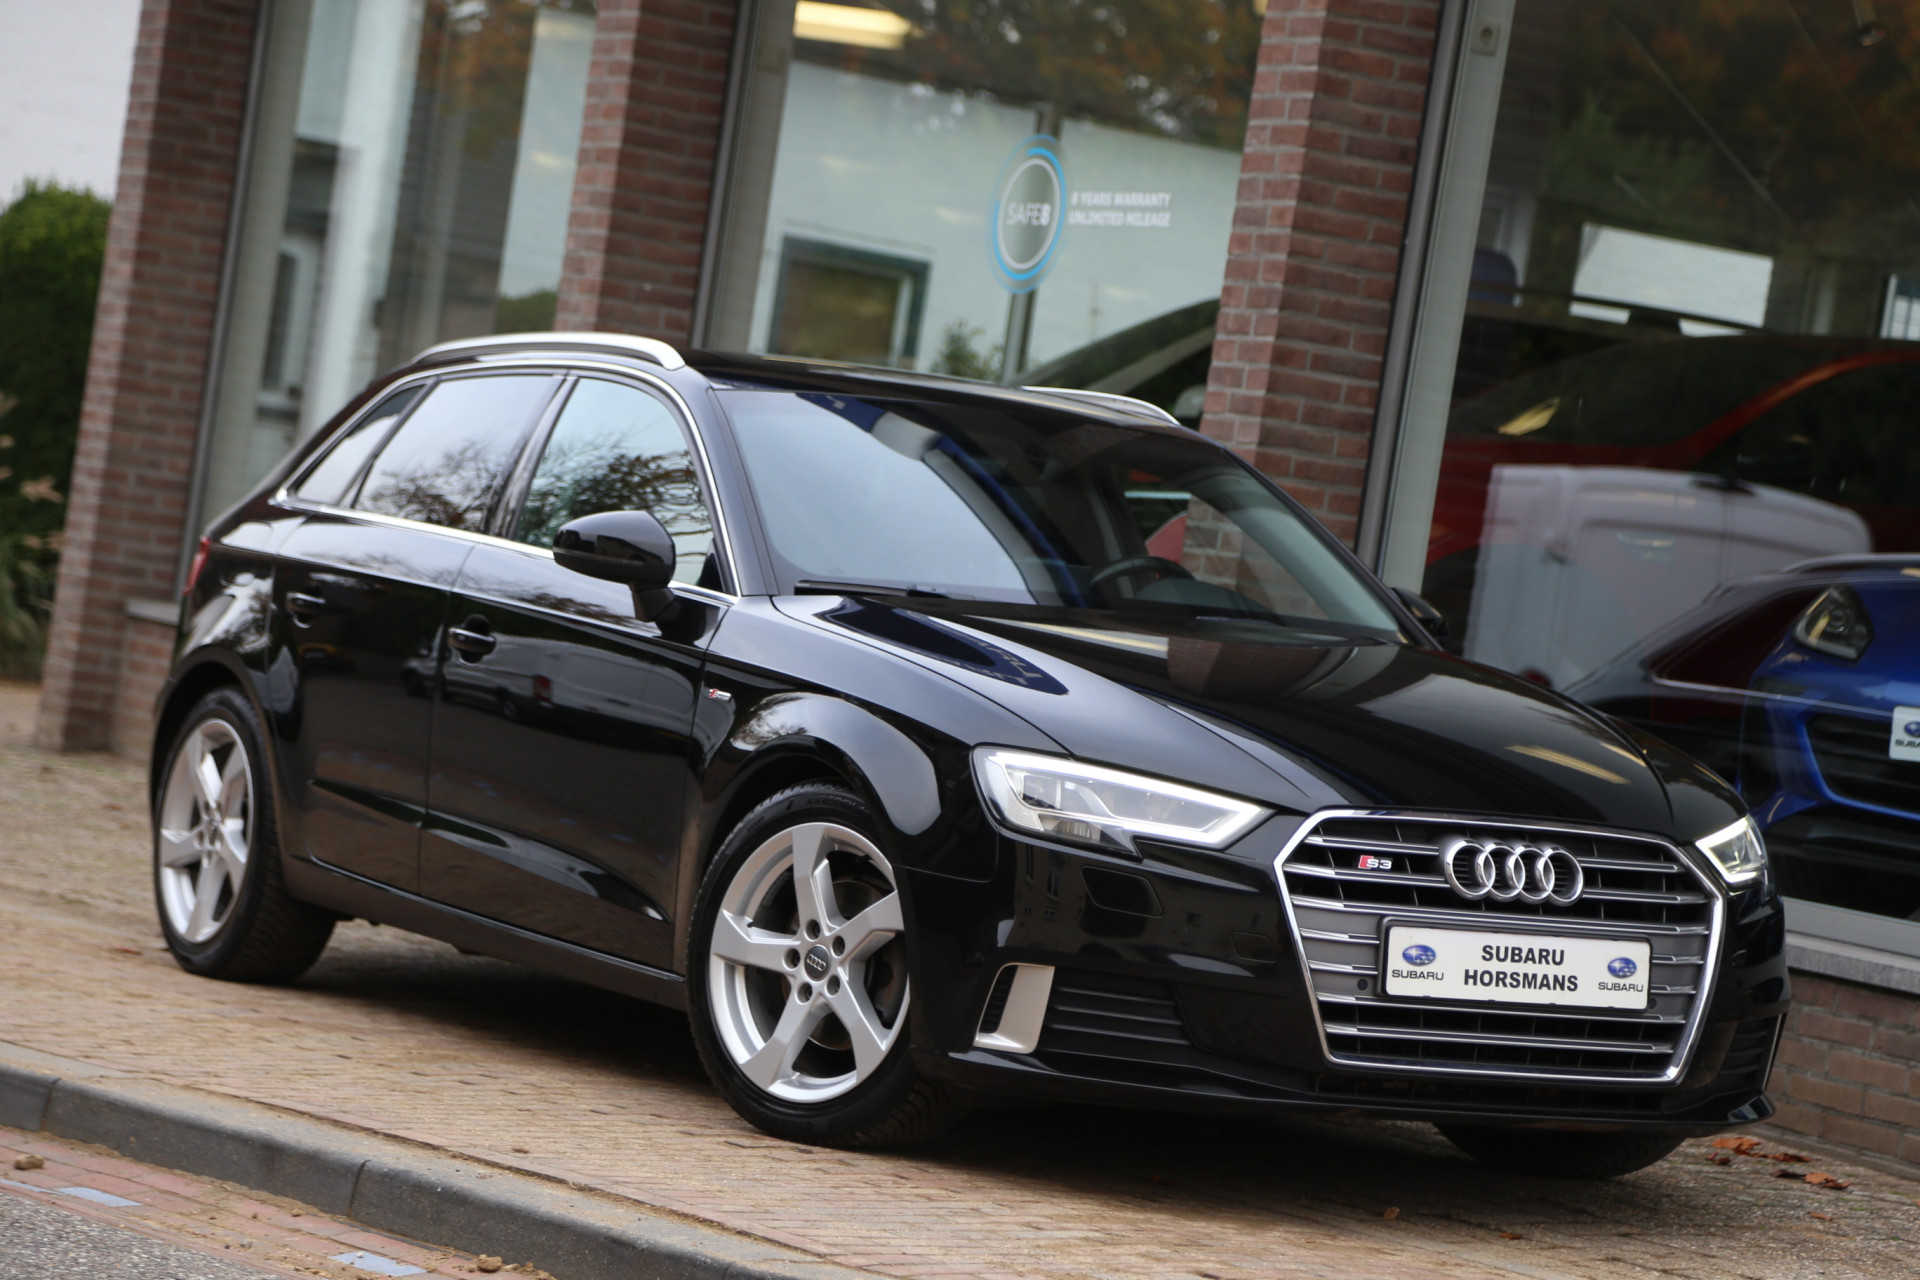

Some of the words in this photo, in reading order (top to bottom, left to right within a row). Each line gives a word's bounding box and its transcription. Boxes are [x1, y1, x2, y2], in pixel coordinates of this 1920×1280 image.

[1081, 191, 1113, 207] YEARS
[1114, 192, 1172, 209] WARRANTY
[1067, 210, 1125, 227] UNLIMITED
[1126, 212, 1171, 229] MILEAGE
[1366, 858, 1392, 870] S3
[1481, 944, 1566, 966] SUBARU
[1391, 969, 1445, 981] SUBARU
[1463, 968, 1579, 992] HORSMANS
[1597, 981, 1644, 993] SUBARU
